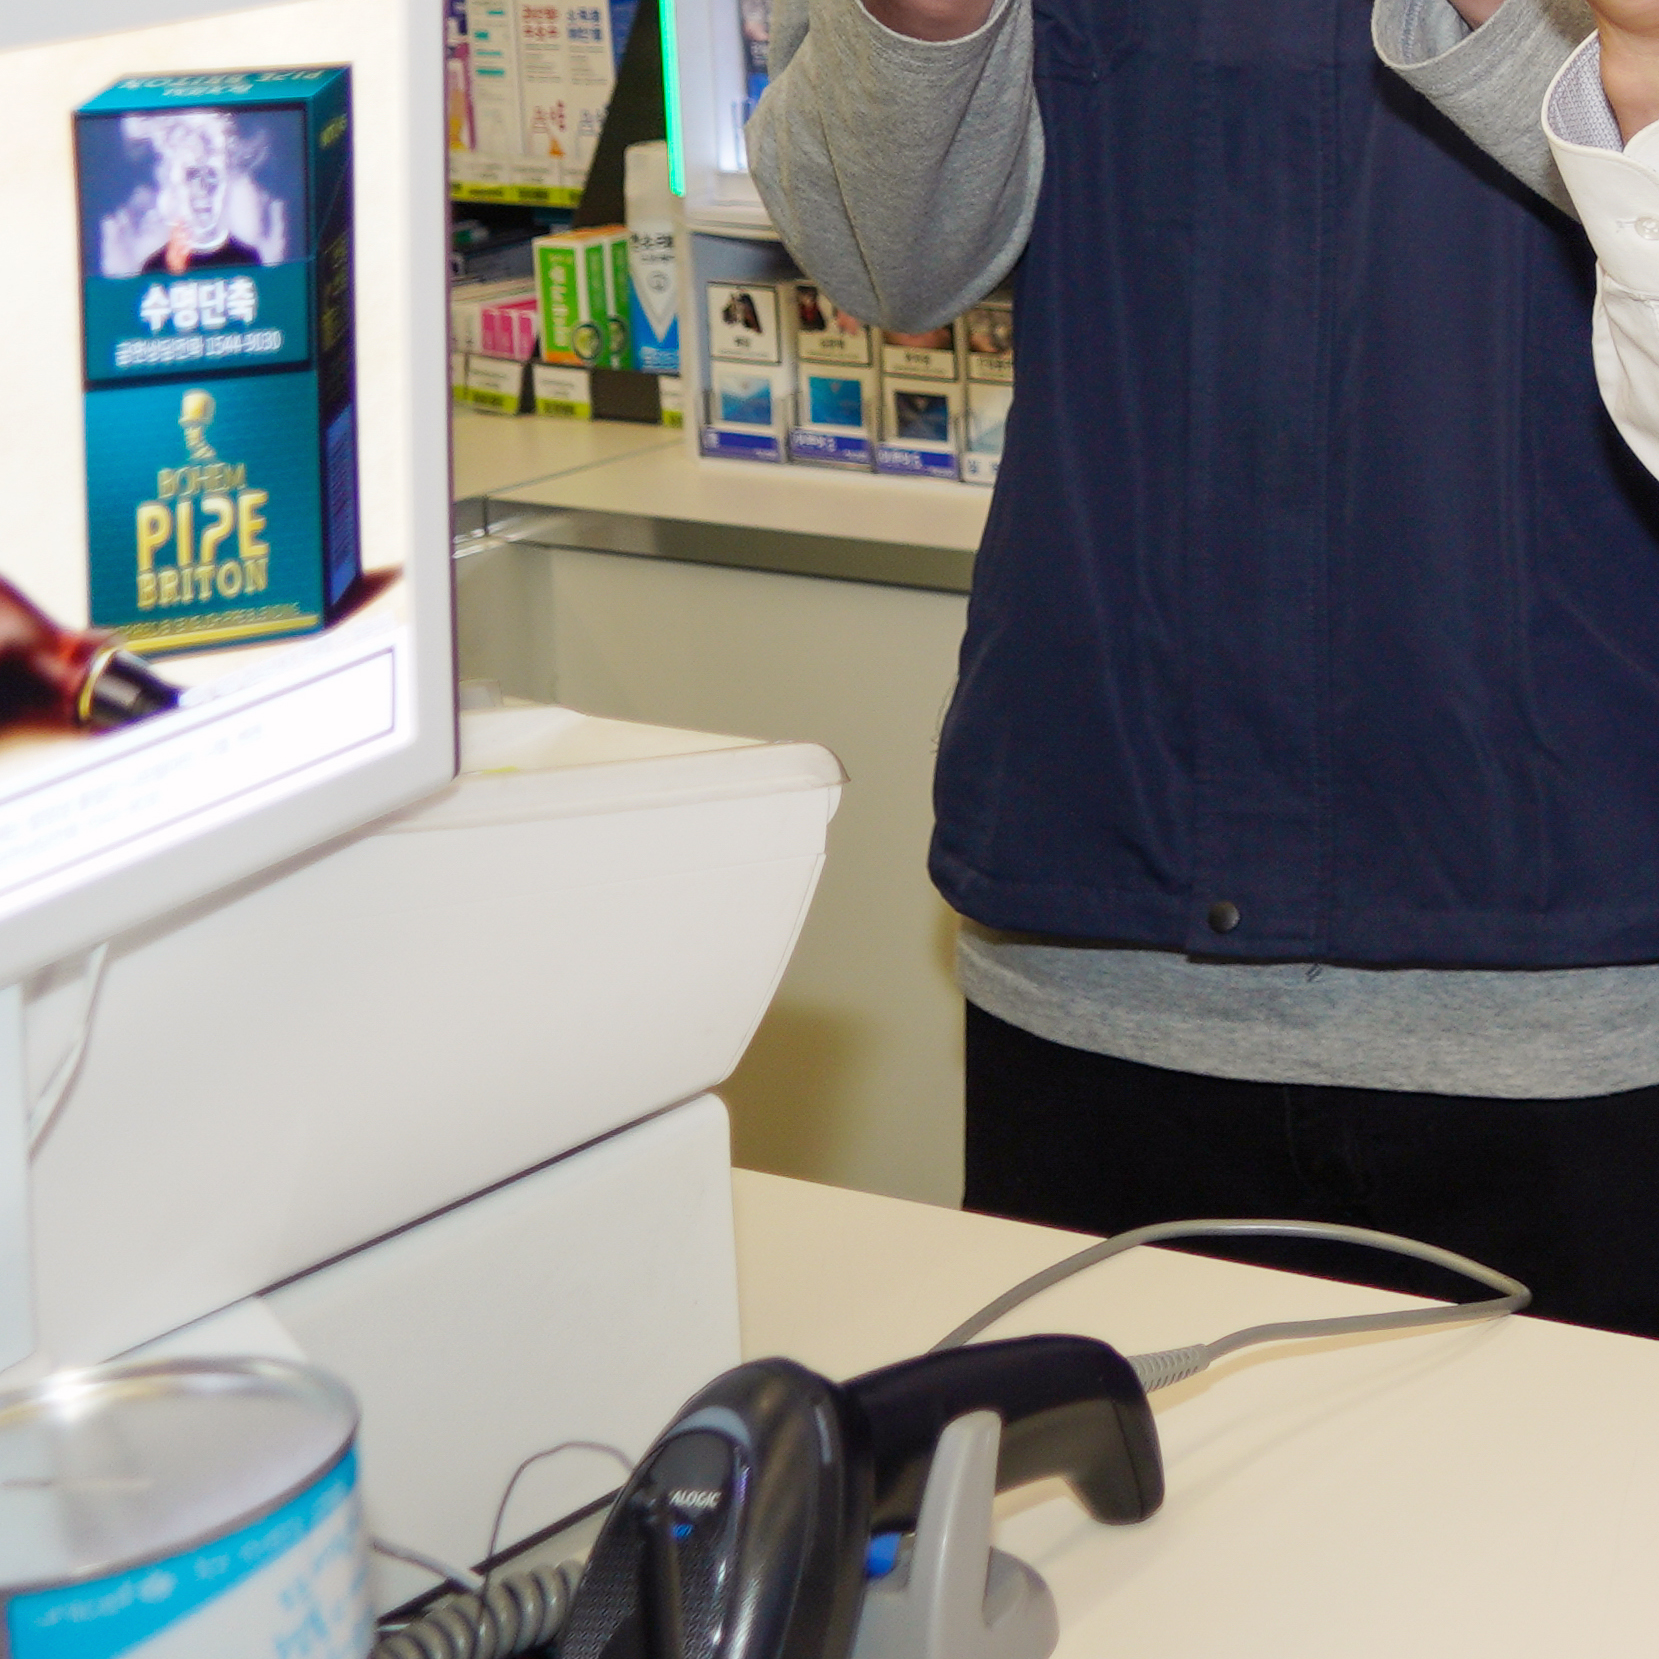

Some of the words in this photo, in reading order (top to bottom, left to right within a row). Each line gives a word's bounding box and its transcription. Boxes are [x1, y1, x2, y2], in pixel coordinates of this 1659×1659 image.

[138, 276, 260, 334] 수명단축
[156, 461, 249, 500] BOHEM
[135, 489, 270, 572] PIPE
[135, 556, 269, 611] BRITON
